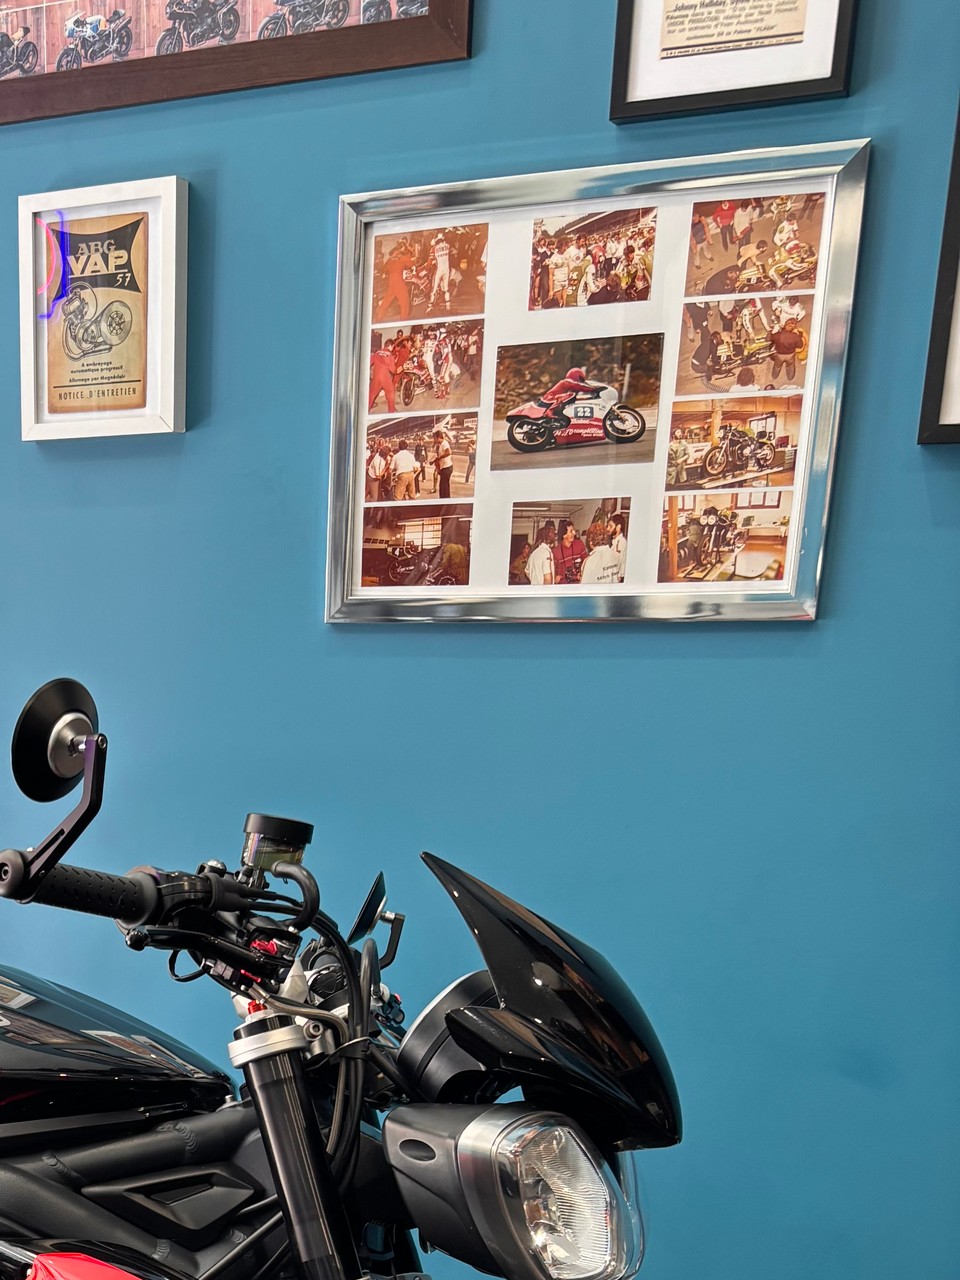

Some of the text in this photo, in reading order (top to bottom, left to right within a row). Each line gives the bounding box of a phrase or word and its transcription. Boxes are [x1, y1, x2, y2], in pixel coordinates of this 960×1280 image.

[76, 240, 116, 257] ABG
[66, 250, 128, 276] VAP
[114, 273, 131, 287] 57
[59, 387, 137, 400] NOTICE D'ENTRETIEN
[577, 407, 591, 417] 22
